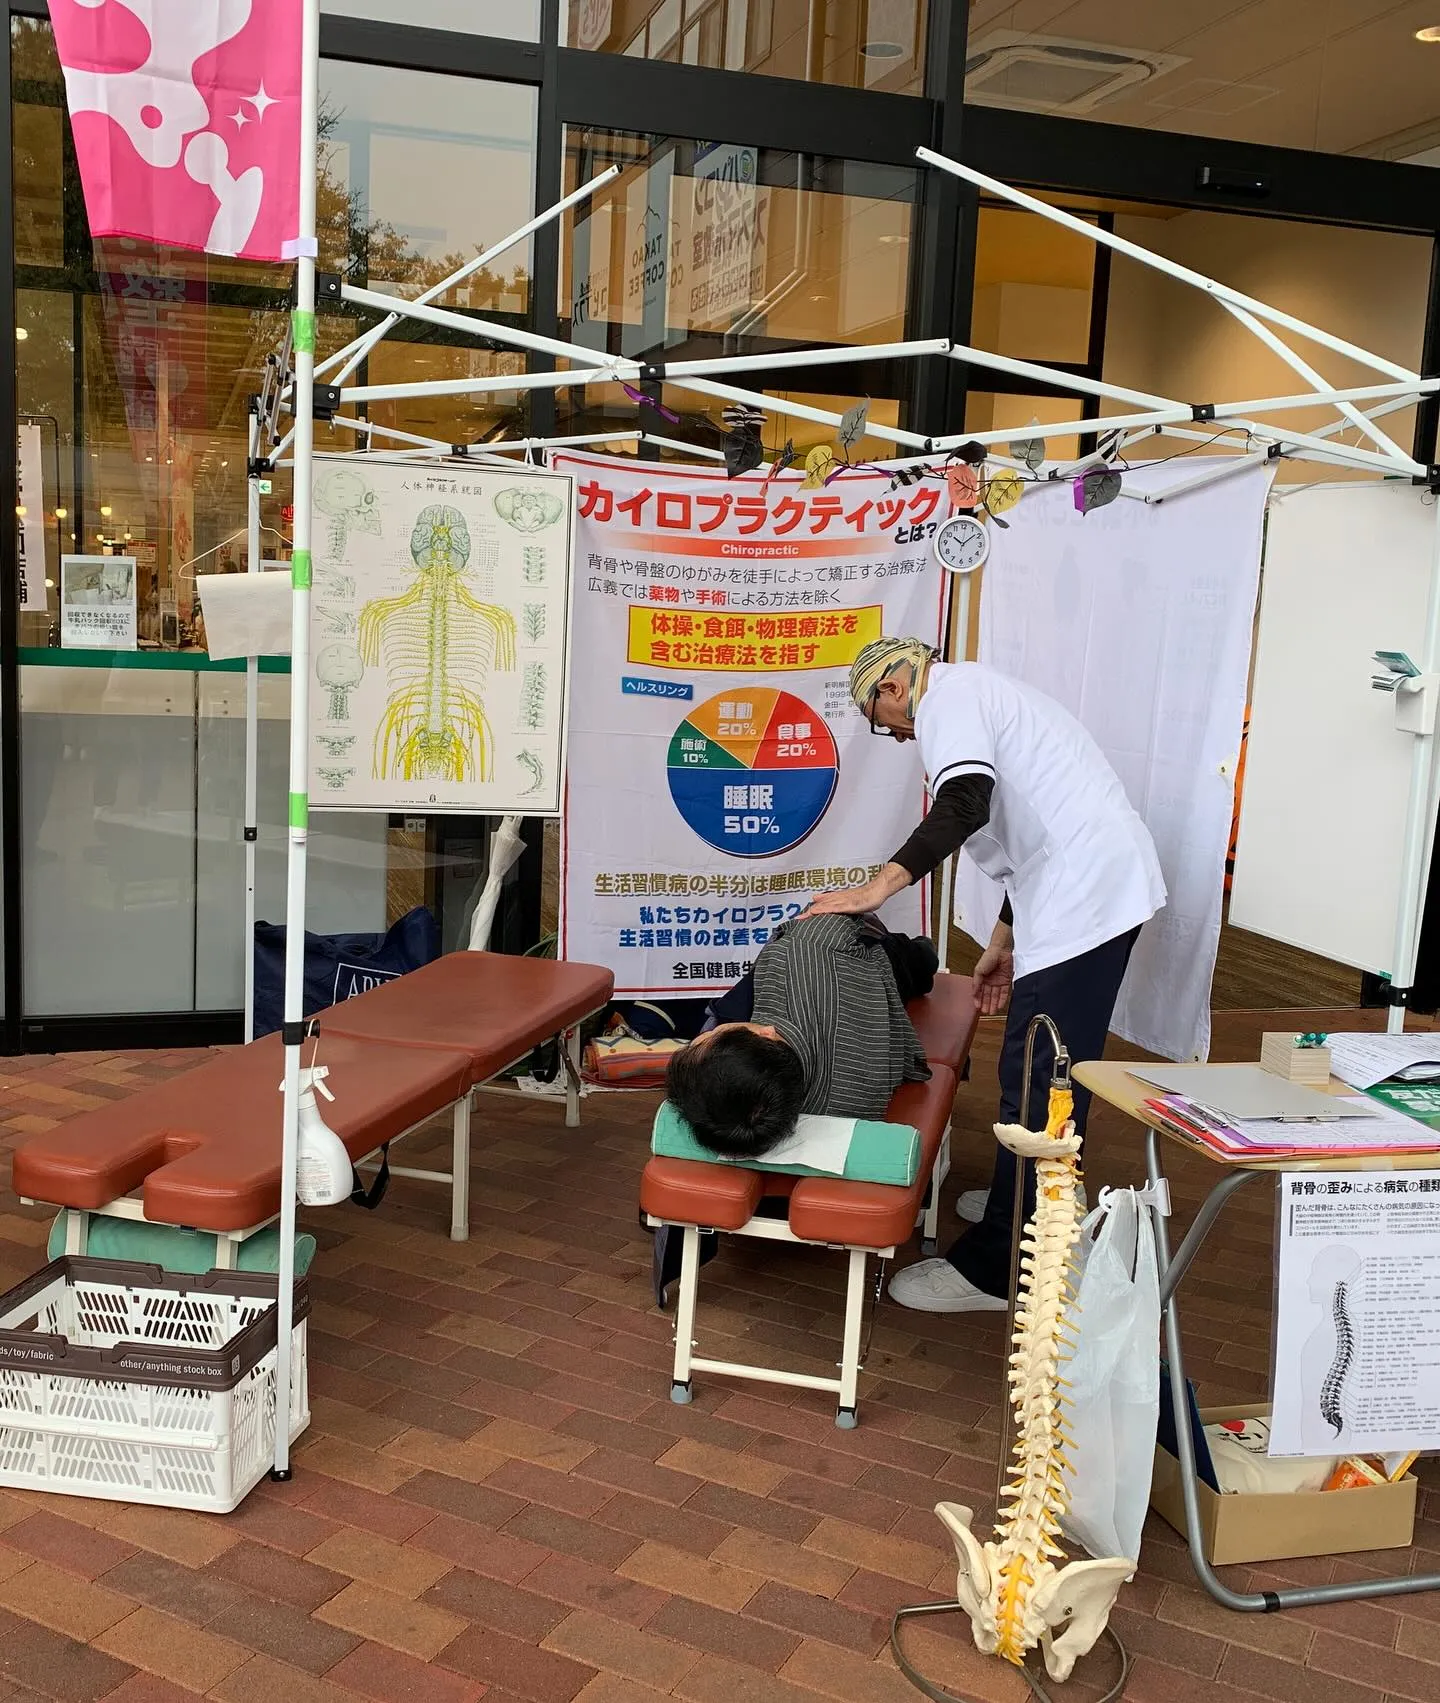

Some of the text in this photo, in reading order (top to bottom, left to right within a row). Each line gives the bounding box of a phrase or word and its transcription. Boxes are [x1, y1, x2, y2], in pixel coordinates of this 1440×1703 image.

[578, 480, 942, 536] カイロプラクティック
[721, 543, 800, 558] Chiropractic
[587, 578, 842, 607] 広義では薬物や手術による方法を除く
[650, 613, 859, 640] 体操・食餌・物理療法を
[650, 640, 820, 666] 含む治療法を指す
[626, 681, 690, 698] ヘルスリング
[718, 701, 753, 719] 運動
[716, 722, 757, 736] 20%
[777, 722, 812, 740] 食事
[681, 738, 707, 751] 施術
[776, 743, 817, 757] 20%
[682, 753, 708, 764] 10%
[723, 785, 773, 810] 睡眠
[723, 816, 780, 834] 50%
[639, 901, 808, 925] 私たちカイロプラク
[619, 927, 781, 948] 生活習慣の改善を
[120, 1359, 222, 1376] other/anything stock box
